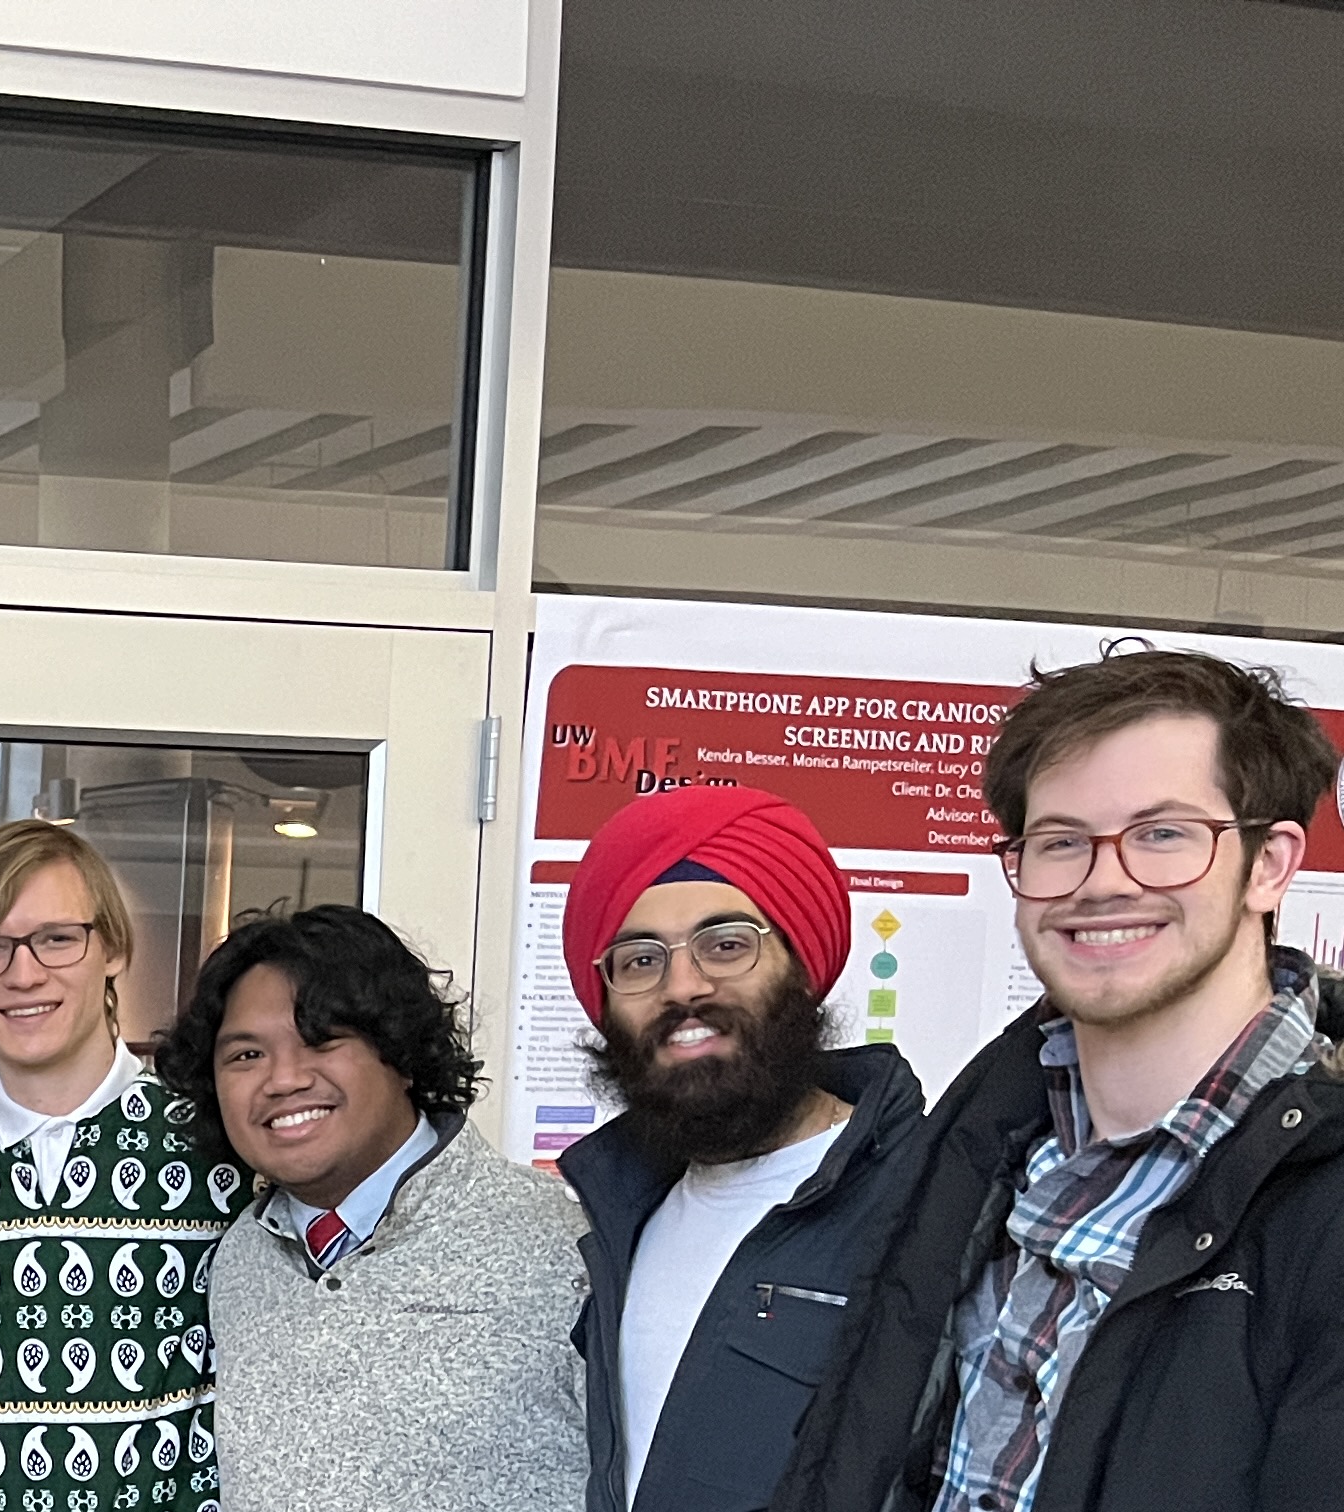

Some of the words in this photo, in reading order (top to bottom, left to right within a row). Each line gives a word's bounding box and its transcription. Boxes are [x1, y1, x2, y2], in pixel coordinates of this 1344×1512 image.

[645, 686, 802, 714] SMARTPHONE
[805, 695, 850, 717] APP
[853, 697, 898, 719] FOR
[902, 700, 1008, 725] CRANIOS
[552, 725, 596, 747] UW
[784, 725, 910, 751] SCREENING
[913, 731, 964, 754] AND
[567, 738, 680, 782] BME
[928, 830, 990, 846] December
